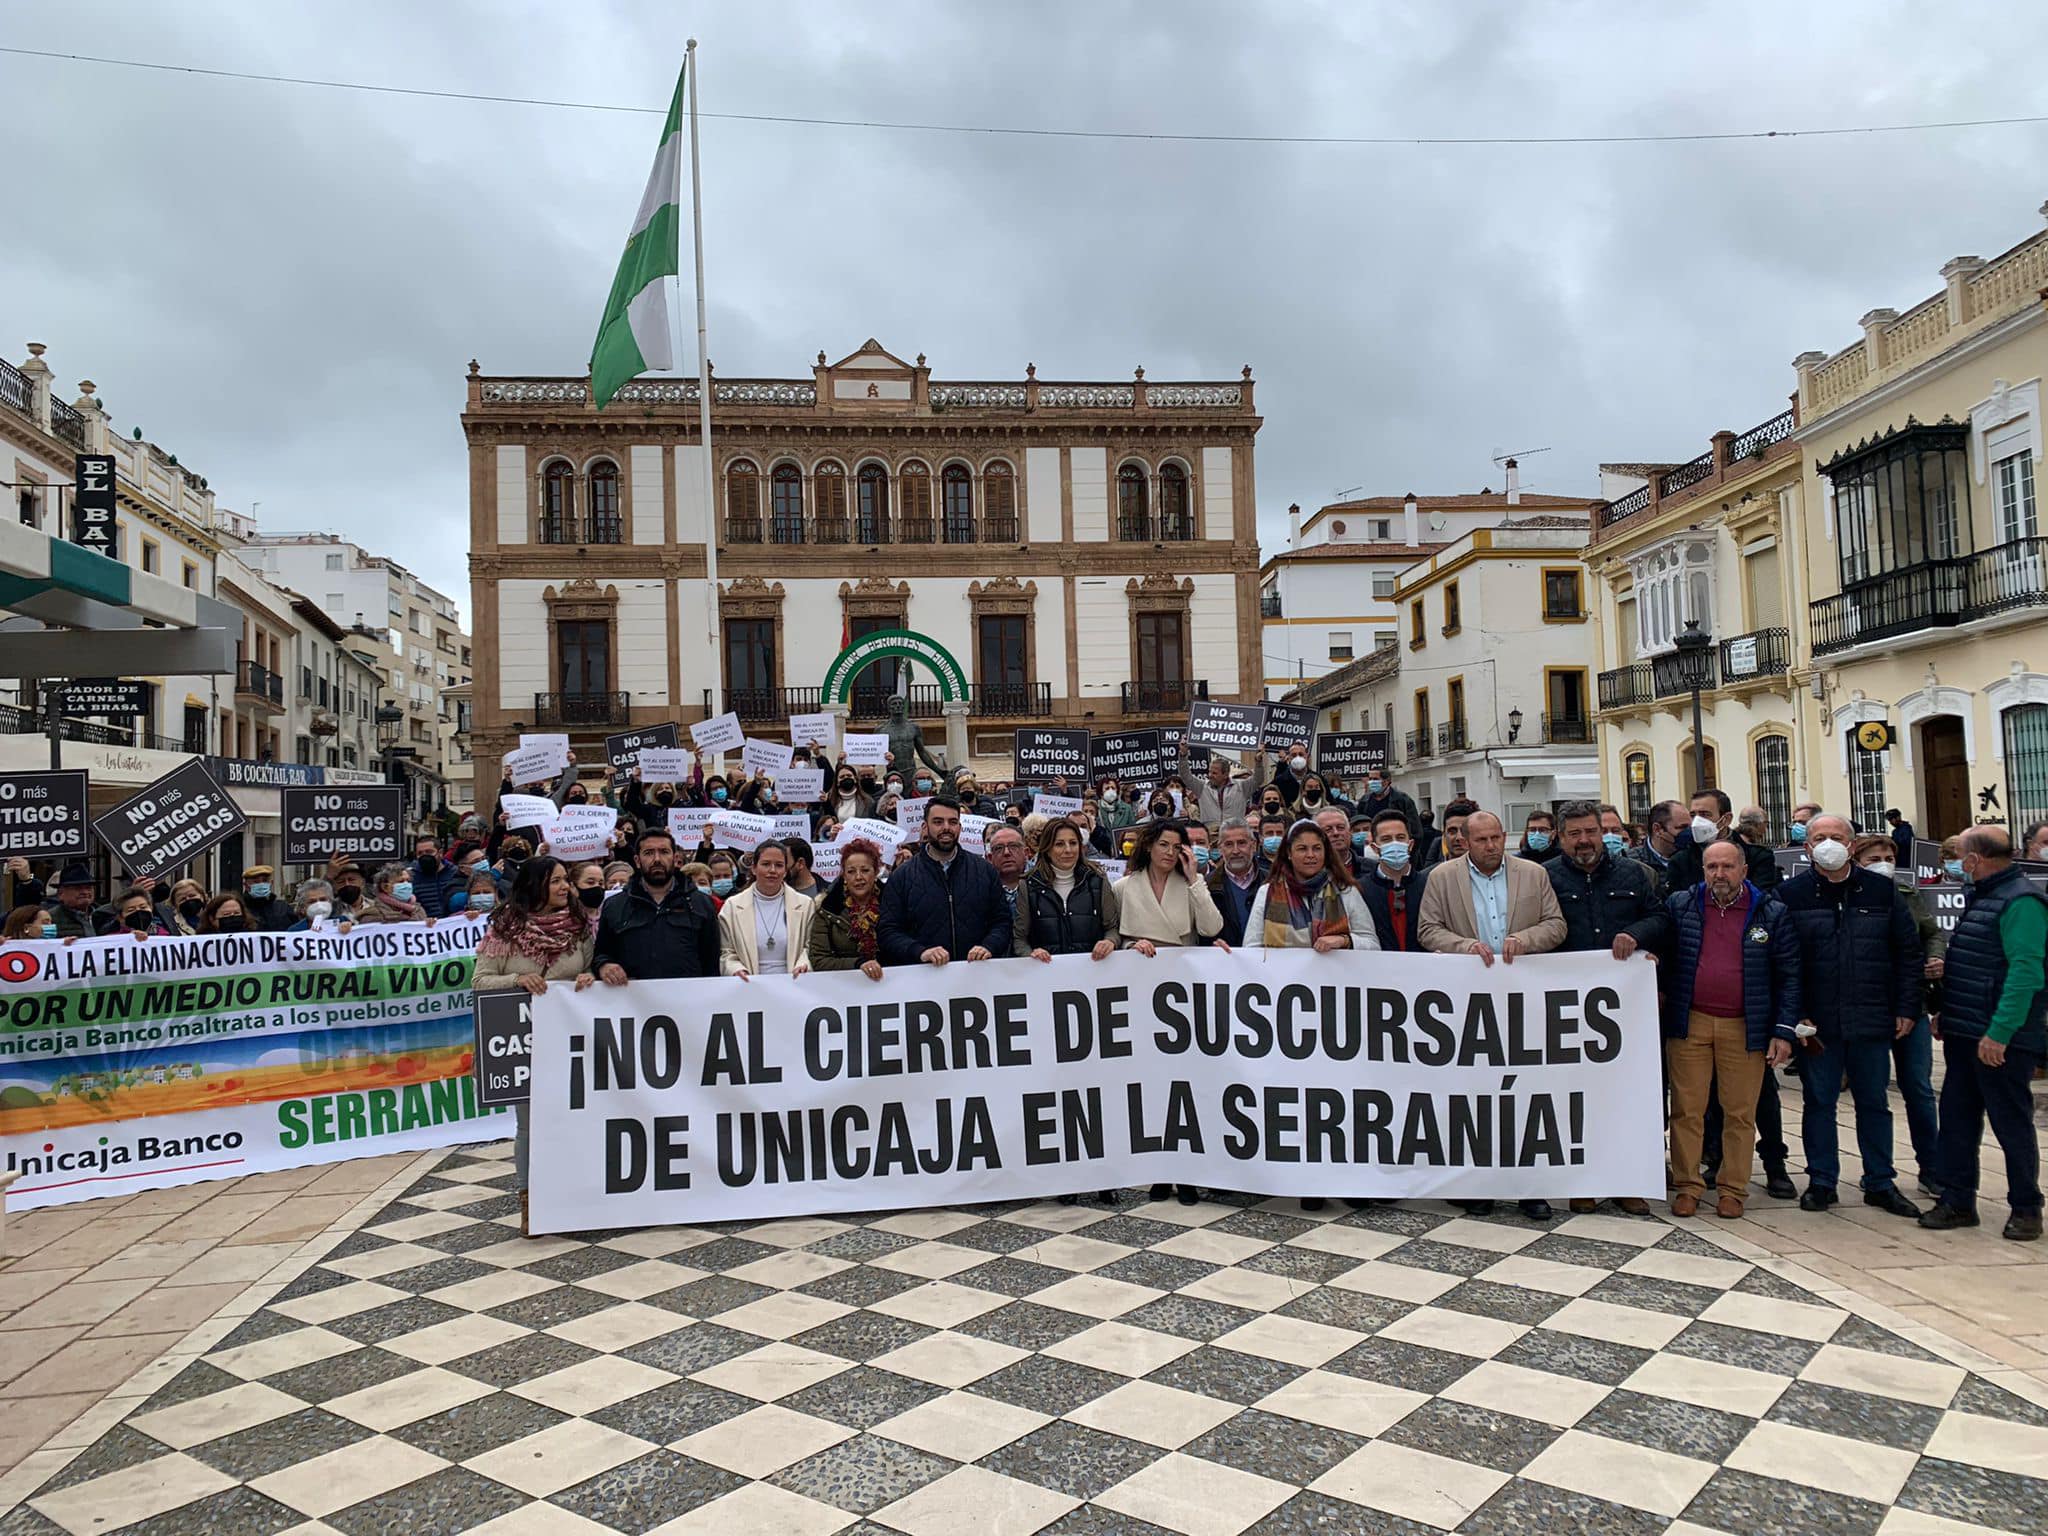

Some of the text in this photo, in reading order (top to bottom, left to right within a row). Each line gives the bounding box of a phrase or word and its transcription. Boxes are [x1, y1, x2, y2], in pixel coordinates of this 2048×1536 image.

[82, 460, 109, 492] EL
[117, 685, 139, 694] DE
[66, 694, 126, 703] CARNES
[67, 703, 140, 712] LA BRASA
[1209, 706, 1245, 720] NO más
[1271, 707, 1301, 721] NO más
[1193, 717, 1253, 733] CASTIGOS
[1264, 721, 1307, 736] ASTIGOS
[623, 735, 641, 749] NO
[1034, 733, 1069, 746] NO más
[1164, 730, 1180, 741] NO
[1190, 732, 1257, 746] los PUEBLOS
[1335, 737, 1368, 748] NO más
[1105, 739, 1140, 751] NO más
[1161, 746, 1177, 757] NO
[1020, 748, 1080, 761] CASTIGOS
[1093, 749, 1158, 767] INJUSTICIAS
[1320, 749, 1385, 763] INJUSTICIAS
[228, 763, 307, 785] BB COCKTAIL BAR
[1019, 763, 1086, 777] los PUEBLOS
[1118, 764, 1159, 779] PUEBLOS
[22, 784, 48, 800] más
[125, 786, 183, 825] NO más
[313, 795, 369, 811] NO más
[914, 804, 922, 812] AL
[1057, 801, 1077, 809] CIERRE
[0, 804, 80, 825] TIGOS a
[120, 791, 221, 856] CASTIGOS a
[290, 815, 396, 833] CASTIGOS a
[550, 826, 562, 834] NO
[574, 822, 599, 831] CIERRE
[718, 820, 762, 833] DE UNICAJA
[780, 820, 804, 828] CIERRE
[875, 823, 899, 836] CIERRE
[136, 807, 235, 877] los PUEBLOS
[555, 832, 600, 845] DE UNICAJA
[721, 831, 756, 844] IGUALEJA
[771, 831, 801, 839] UNICAJA
[863, 827, 893, 843] UNICAJA
[290, 836, 396, 854] los PUEBLOS
[560, 843, 597, 855] IGUALEJA
[814, 849, 824, 857] AL
[1937, 893, 1967, 909] NO
[43, 952, 60, 982] A
[66, 949, 98, 980] LA
[104, 934, 255, 977] ELIMINACIÓN
[260, 935, 288, 964] DE
[292, 931, 399, 962] SERVICIOS
[404, 923, 486, 957] ESENCIA
[77, 988, 135, 1022] UN
[141, 976, 262, 1016] MEDIO
[269, 969, 380, 1004] RURAL
[387, 960, 466, 994] VIVO
[85, 1025, 163, 1048] Banco
[168, 1013, 267, 1039] maltrata
[271, 1013, 285, 1027] a
[290, 1007, 321, 1026] los
[326, 1002, 411, 1026] pueblos
[416, 997, 442, 1015] de
[569, 1015, 683, 1111] ¡NO
[700, 1010, 783, 1087] AL
[803, 992, 1033, 1082] CIERRE
[1052, 985, 1133, 1064] DE
[1152, 980, 1623, 1068] SUSCURSALES
[489, 1073, 510, 1090] los
[277, 1074, 508, 1150] SERRANI
[604, 1074, 1586, 1195] DE UNICAJA EN LA SERRANÍA!
[138, 1131, 244, 1162] Banco
